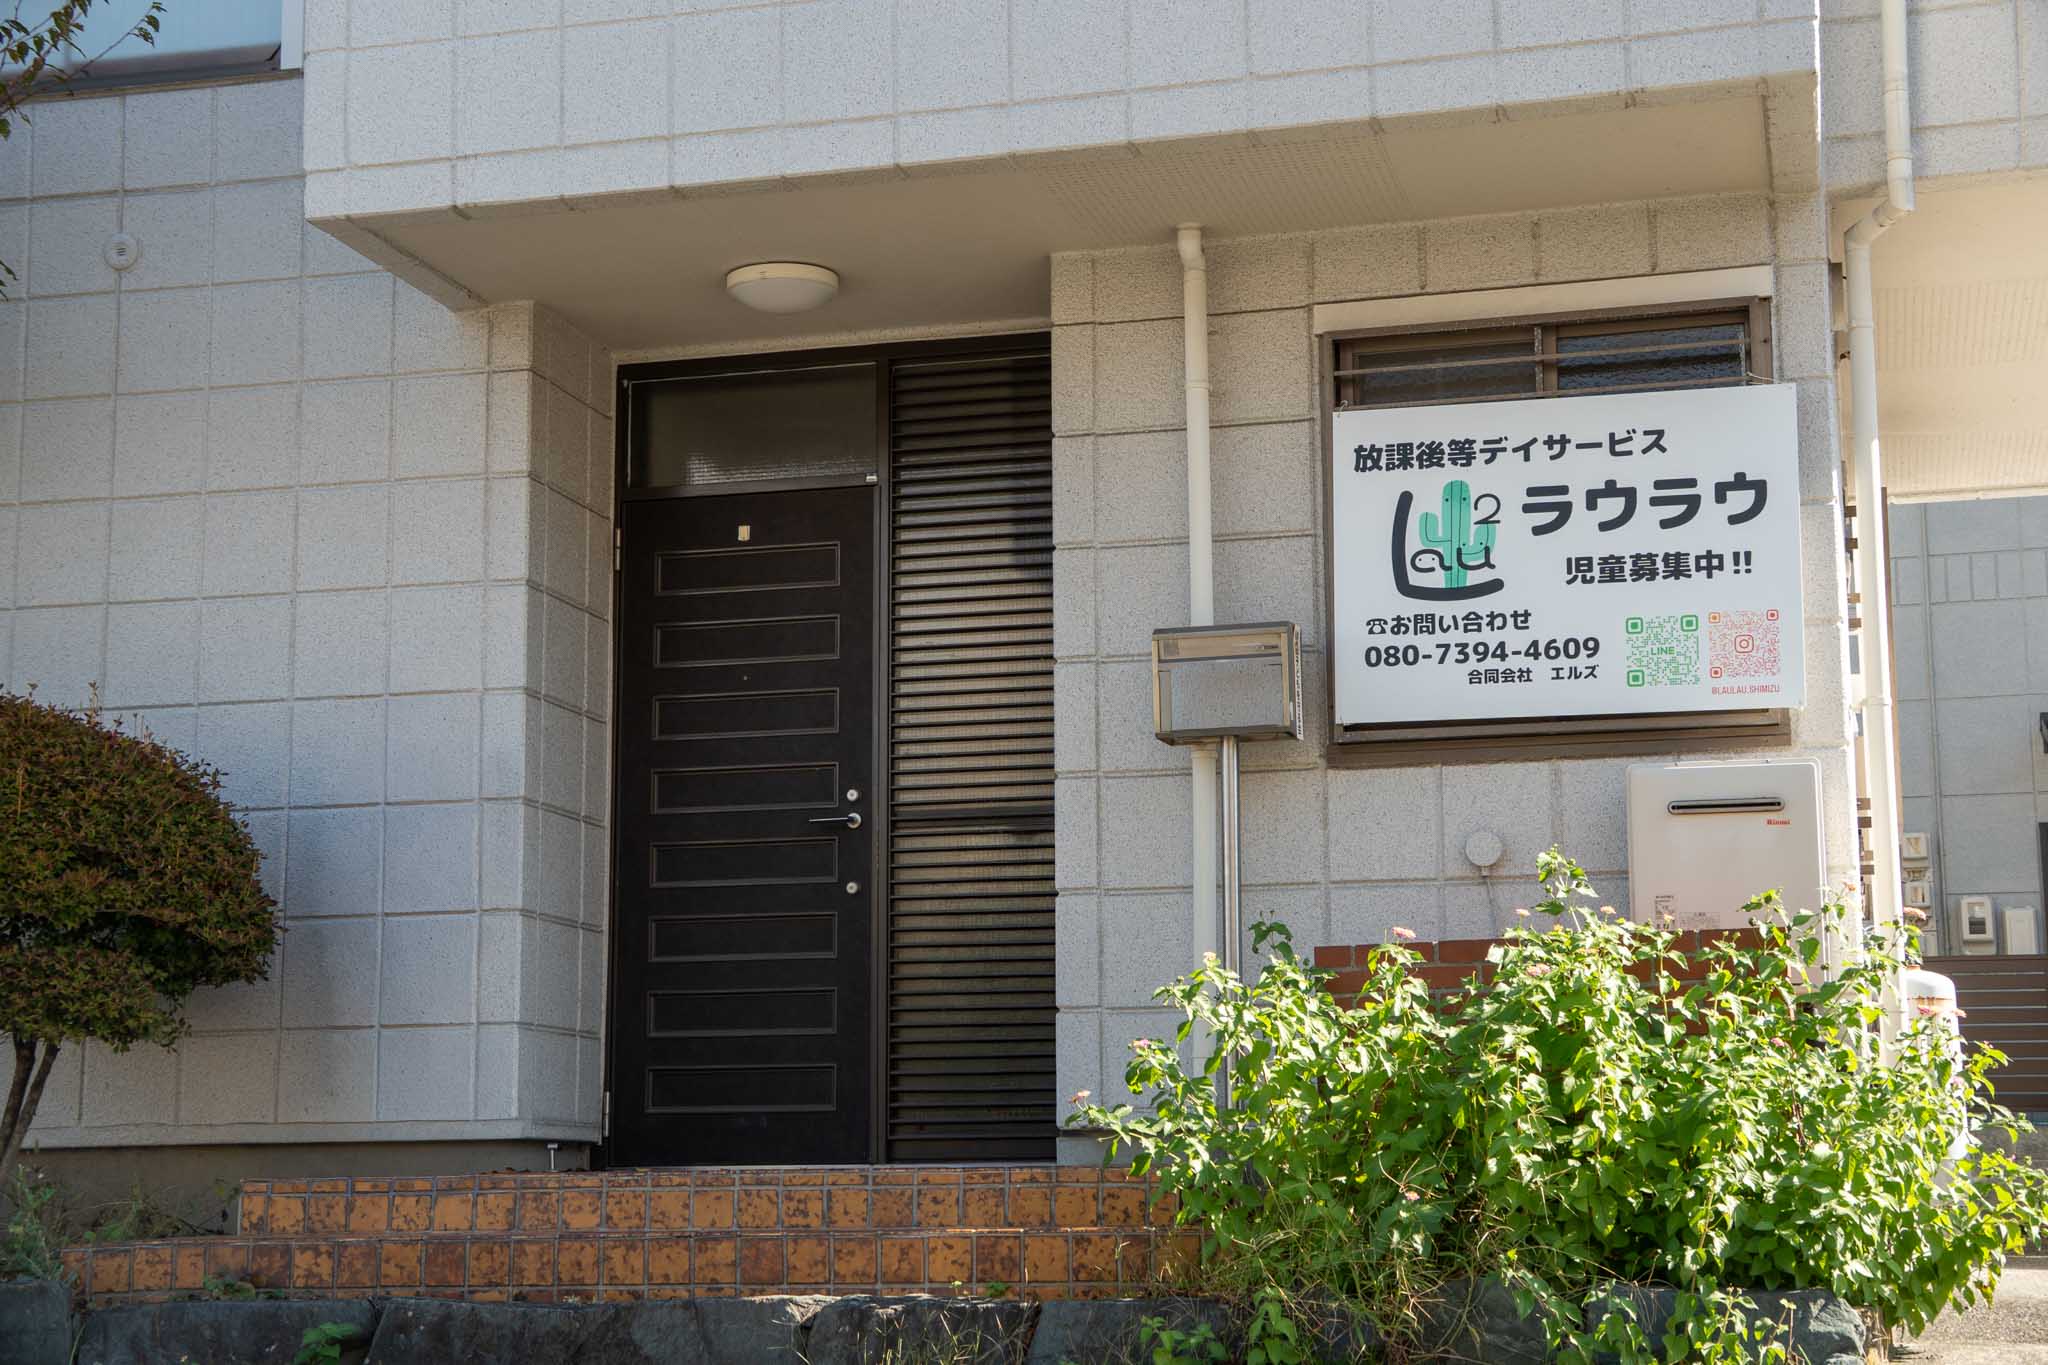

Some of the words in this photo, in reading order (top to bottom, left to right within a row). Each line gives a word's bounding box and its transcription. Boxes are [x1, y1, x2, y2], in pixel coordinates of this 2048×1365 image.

[1353, 428, 1668, 473] 放課後等デイサービス
[1521, 471, 1768, 537] ラウラウ
[1565, 550, 1753, 585] 児童募集中!!
[1364, 637, 1600, 668] 080-7394-4609
[1650, 646, 1675, 656] LINE
[1467, 667, 1533, 685] 合同会社
[1551, 664, 1599, 681] エルズ
